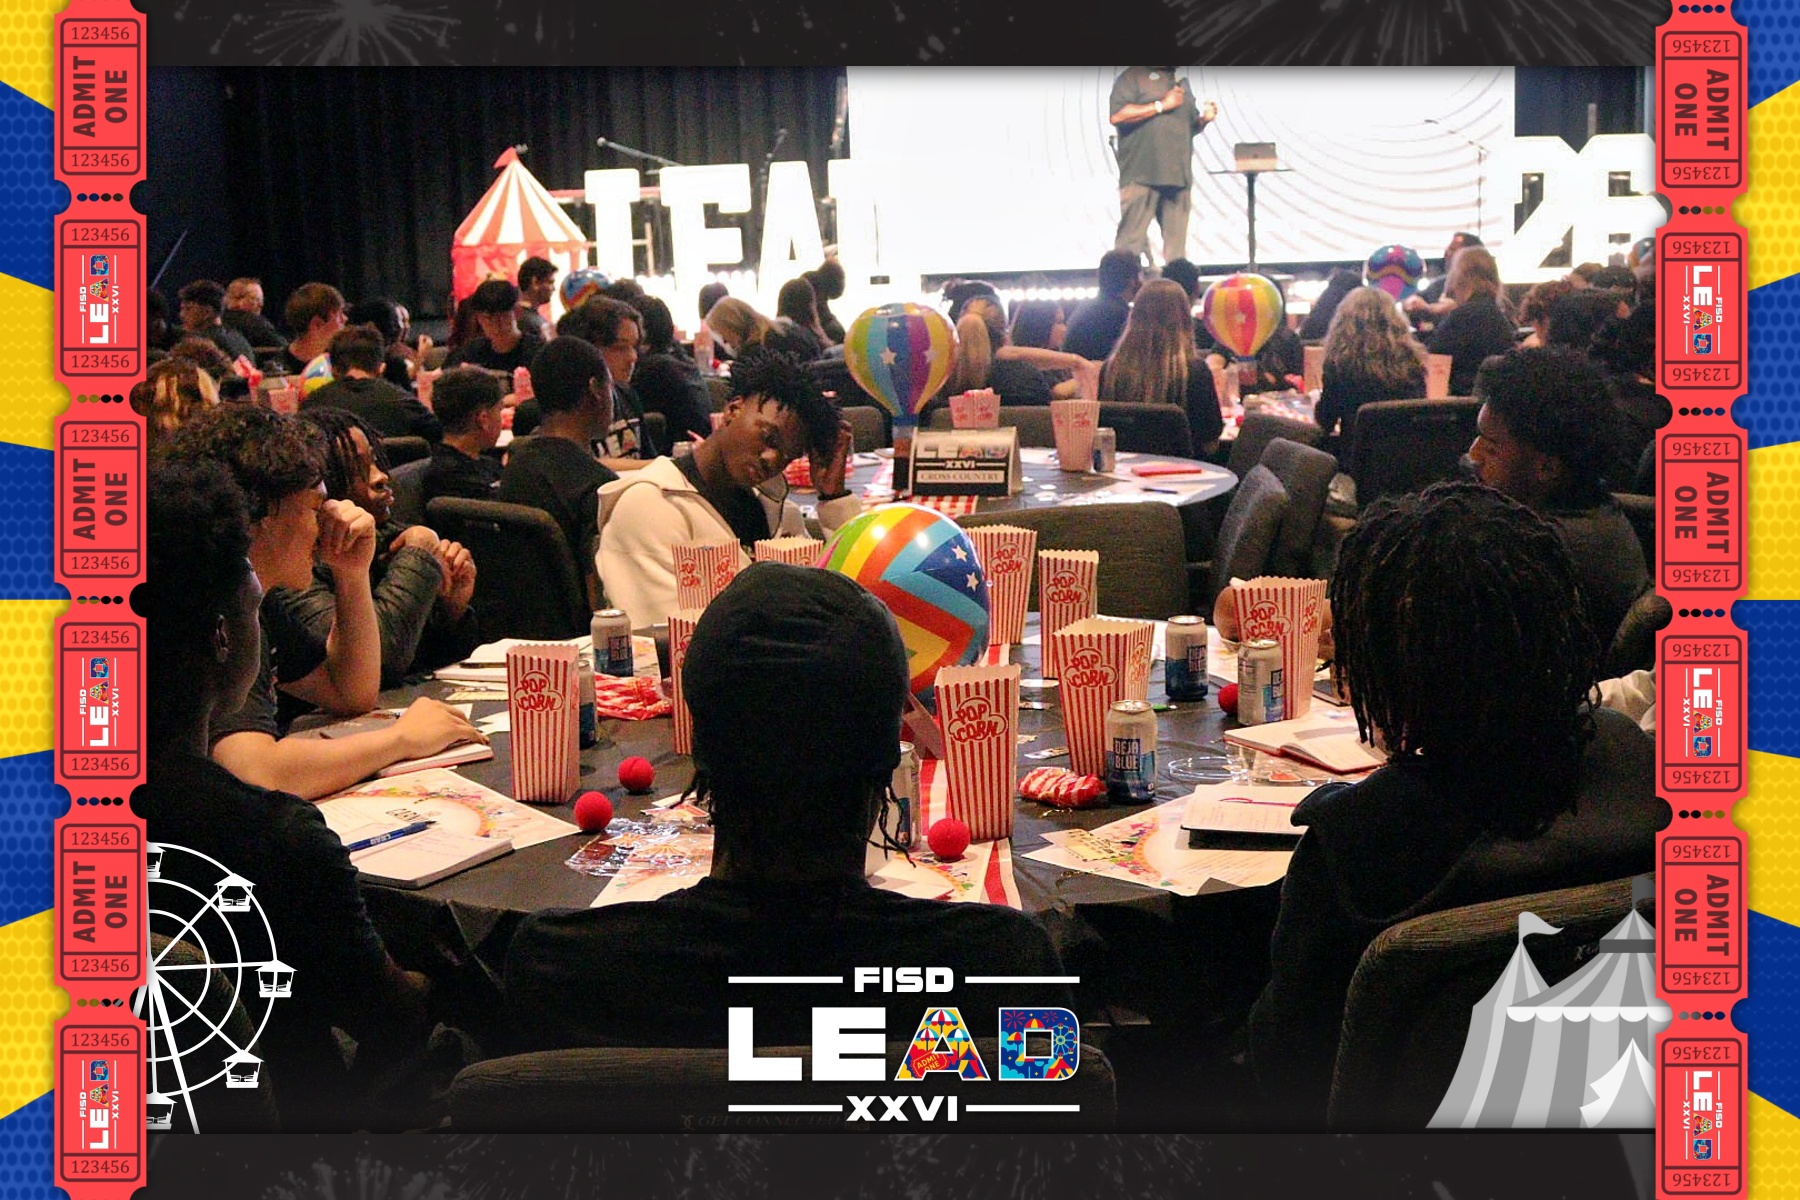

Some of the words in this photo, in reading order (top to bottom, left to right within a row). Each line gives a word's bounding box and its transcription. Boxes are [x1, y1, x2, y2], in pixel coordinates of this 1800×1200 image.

[945, 460, 976, 469] XXVI
[921, 471, 951, 481] CROSS
[953, 471, 999, 481] COUNTRY
[996, 548, 1016, 562] POP
[994, 560, 1023, 574] CORN
[1052, 576, 1075, 588] POP
[1050, 589, 1082, 603] CORN
[1250, 607, 1276, 623] POP
[1071, 654, 1099, 672] POP
[520, 678, 547, 694] POP
[1070, 670, 1110, 688] CORN
[519, 693, 557, 711] CORN
[955, 704, 987, 725] POP
[956, 720, 998, 743] CORN
[1115, 740, 1139, 755] DEJA
[1115, 755, 1139, 770] BLUE
[698, 1115, 733, 1127] GET
[736, 1114, 840, 1127] CONNECTED
